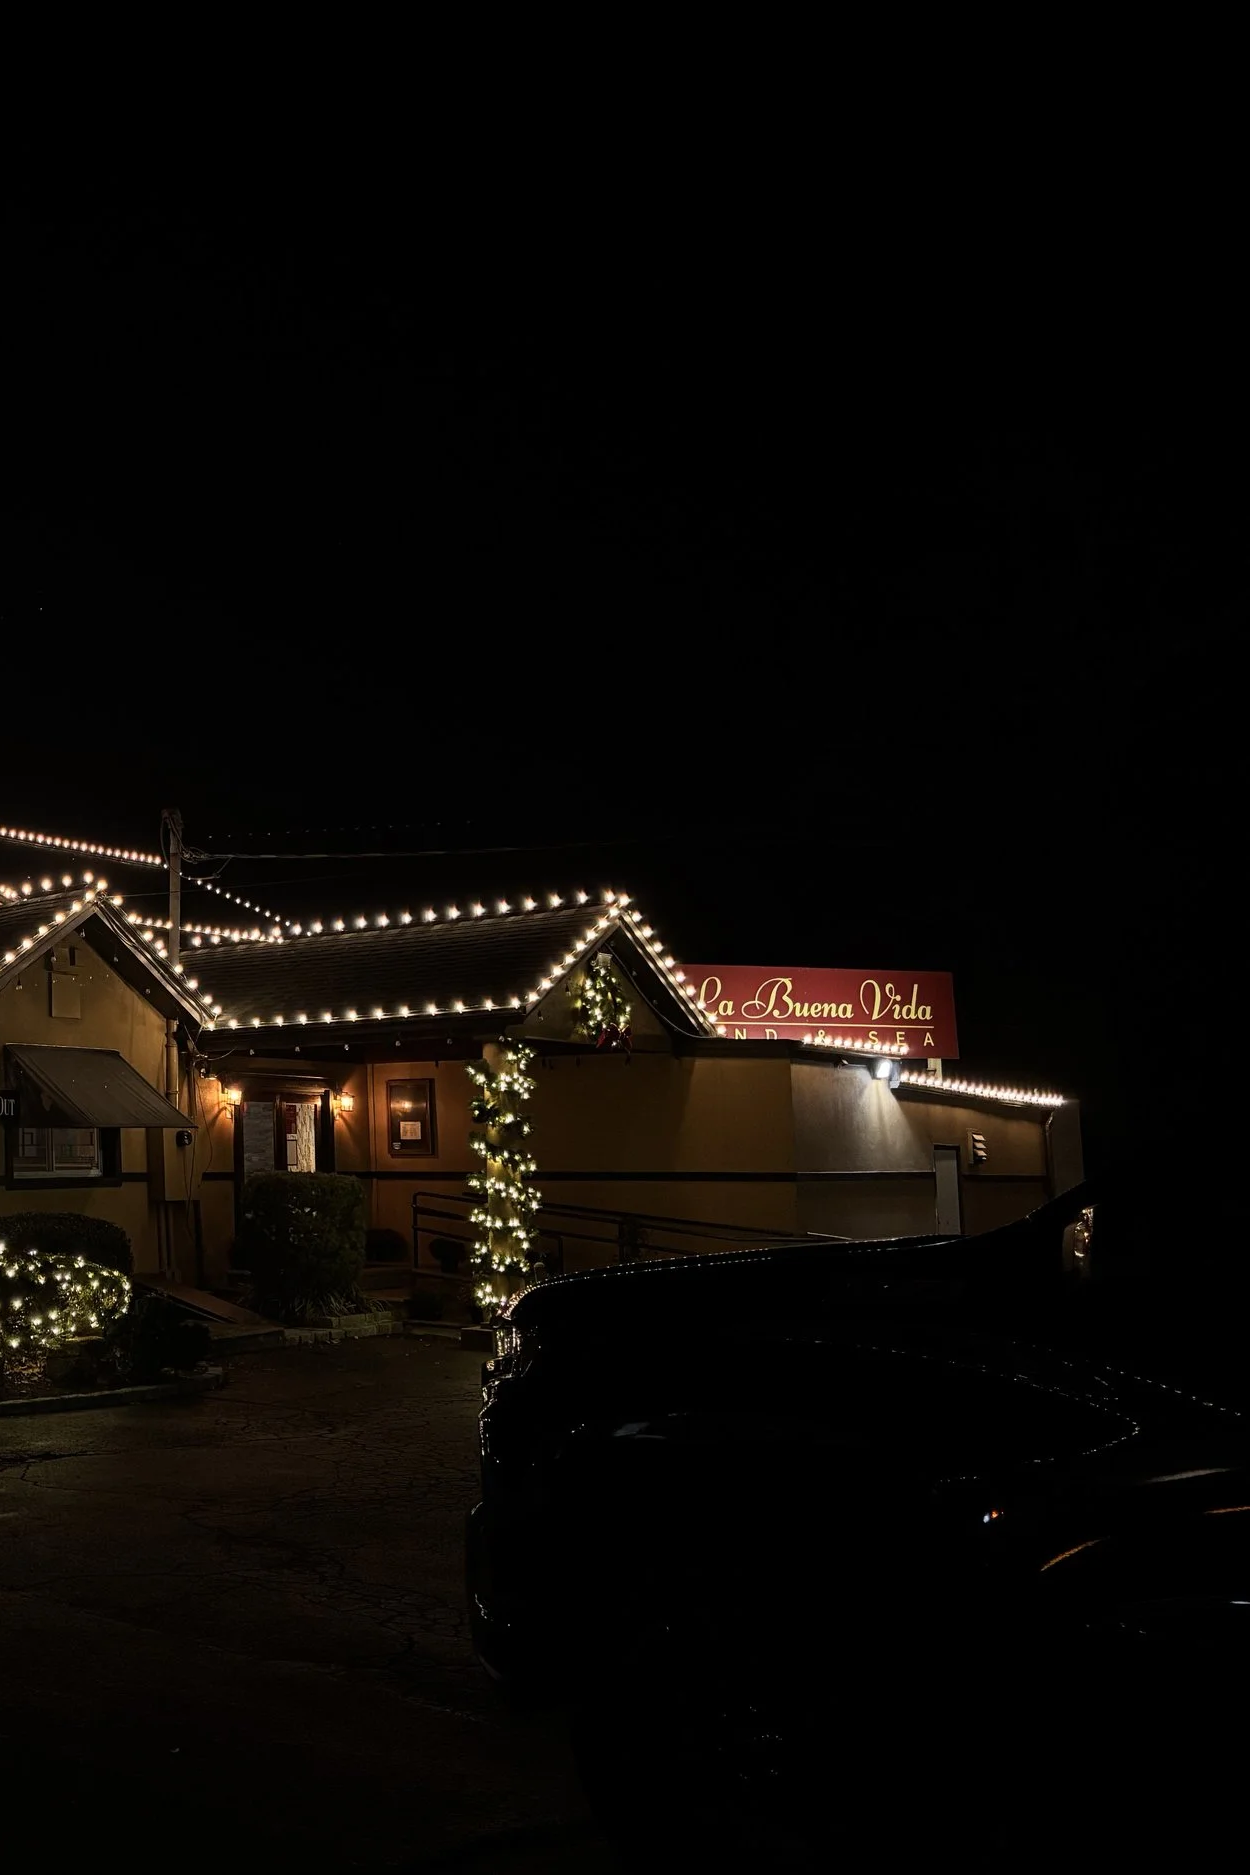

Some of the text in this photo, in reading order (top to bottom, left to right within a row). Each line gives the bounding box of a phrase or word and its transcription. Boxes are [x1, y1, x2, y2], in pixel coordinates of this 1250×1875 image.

[699, 976, 933, 1021] La Buena Vida
[868, 1030, 935, 1047] SEA
